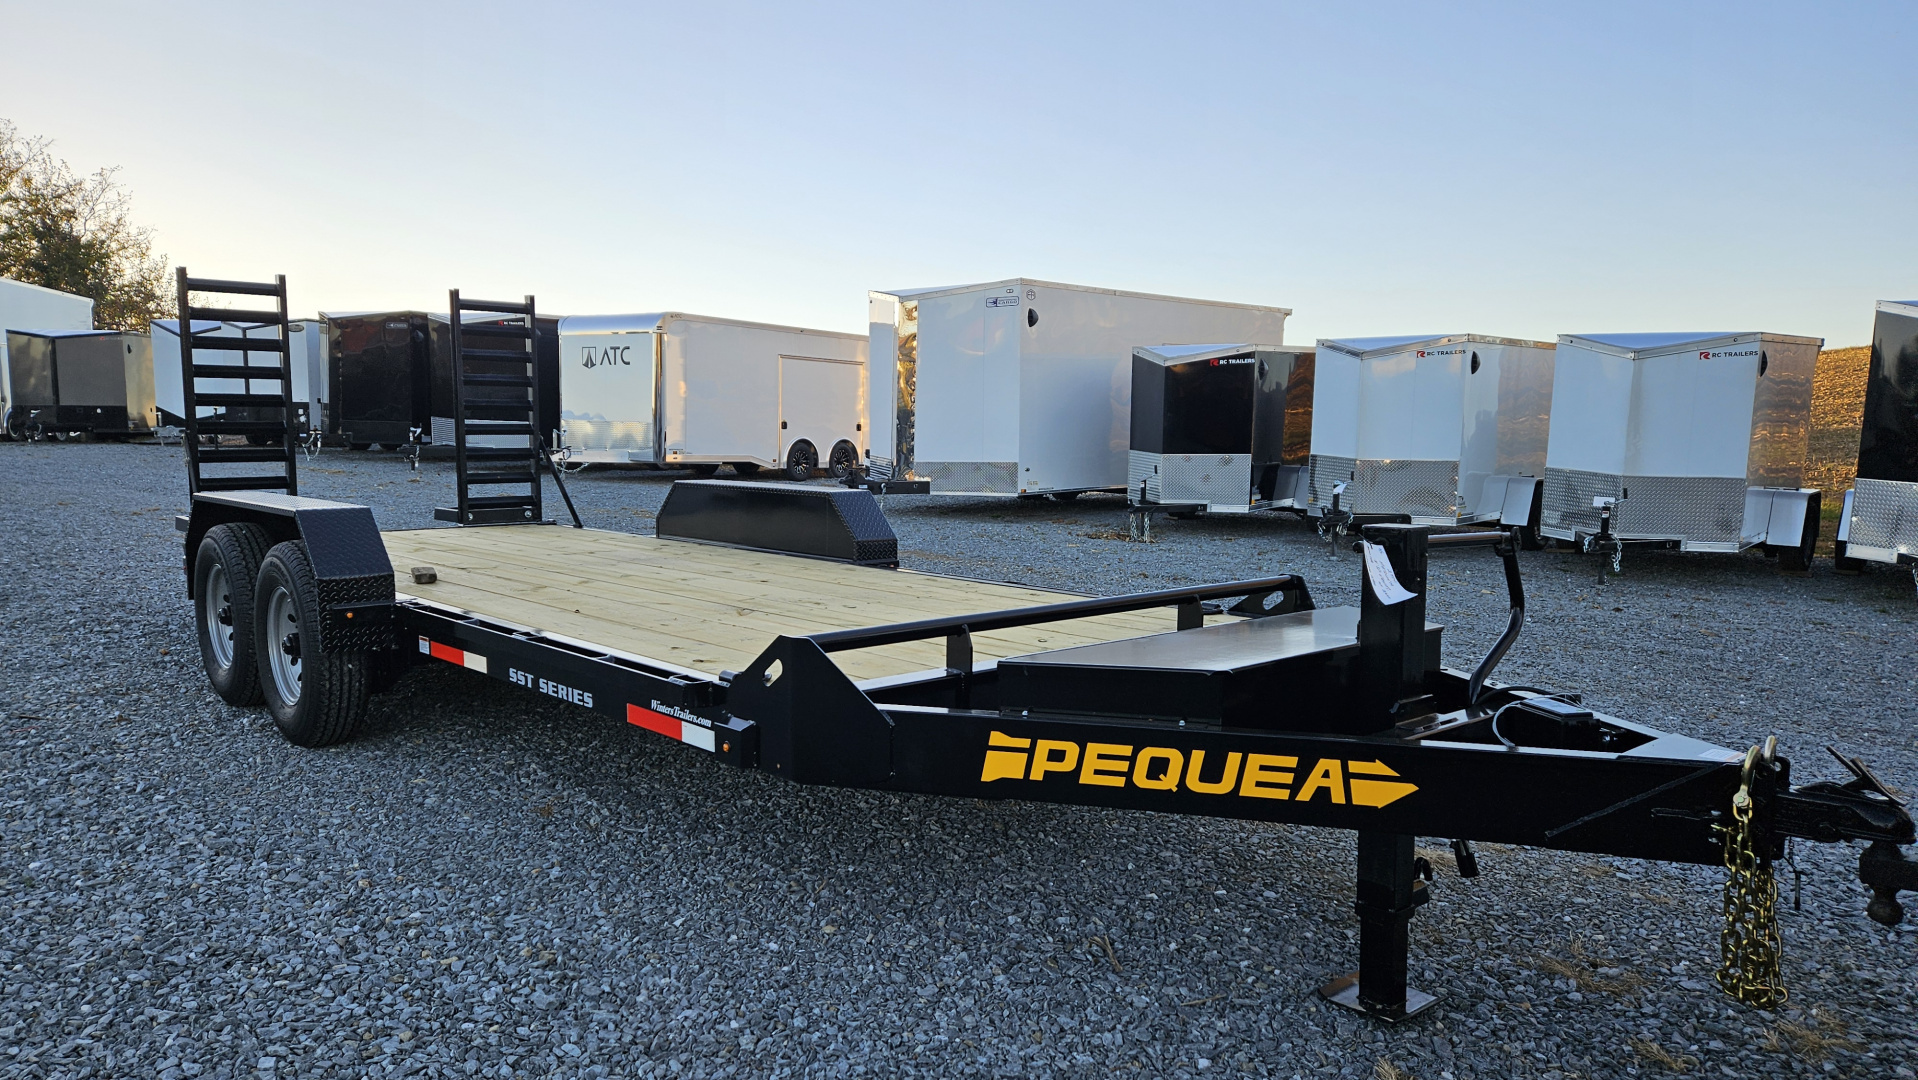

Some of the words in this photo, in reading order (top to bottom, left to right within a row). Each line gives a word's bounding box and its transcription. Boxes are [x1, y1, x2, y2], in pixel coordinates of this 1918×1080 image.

[600, 346, 630, 365] ATC
[509, 667, 534, 688] SST
[539, 678, 593, 708] SERIES
[651, 699, 712, 728] WintersTrailers.com
[1029, 739, 1346, 805] PEQUEA
